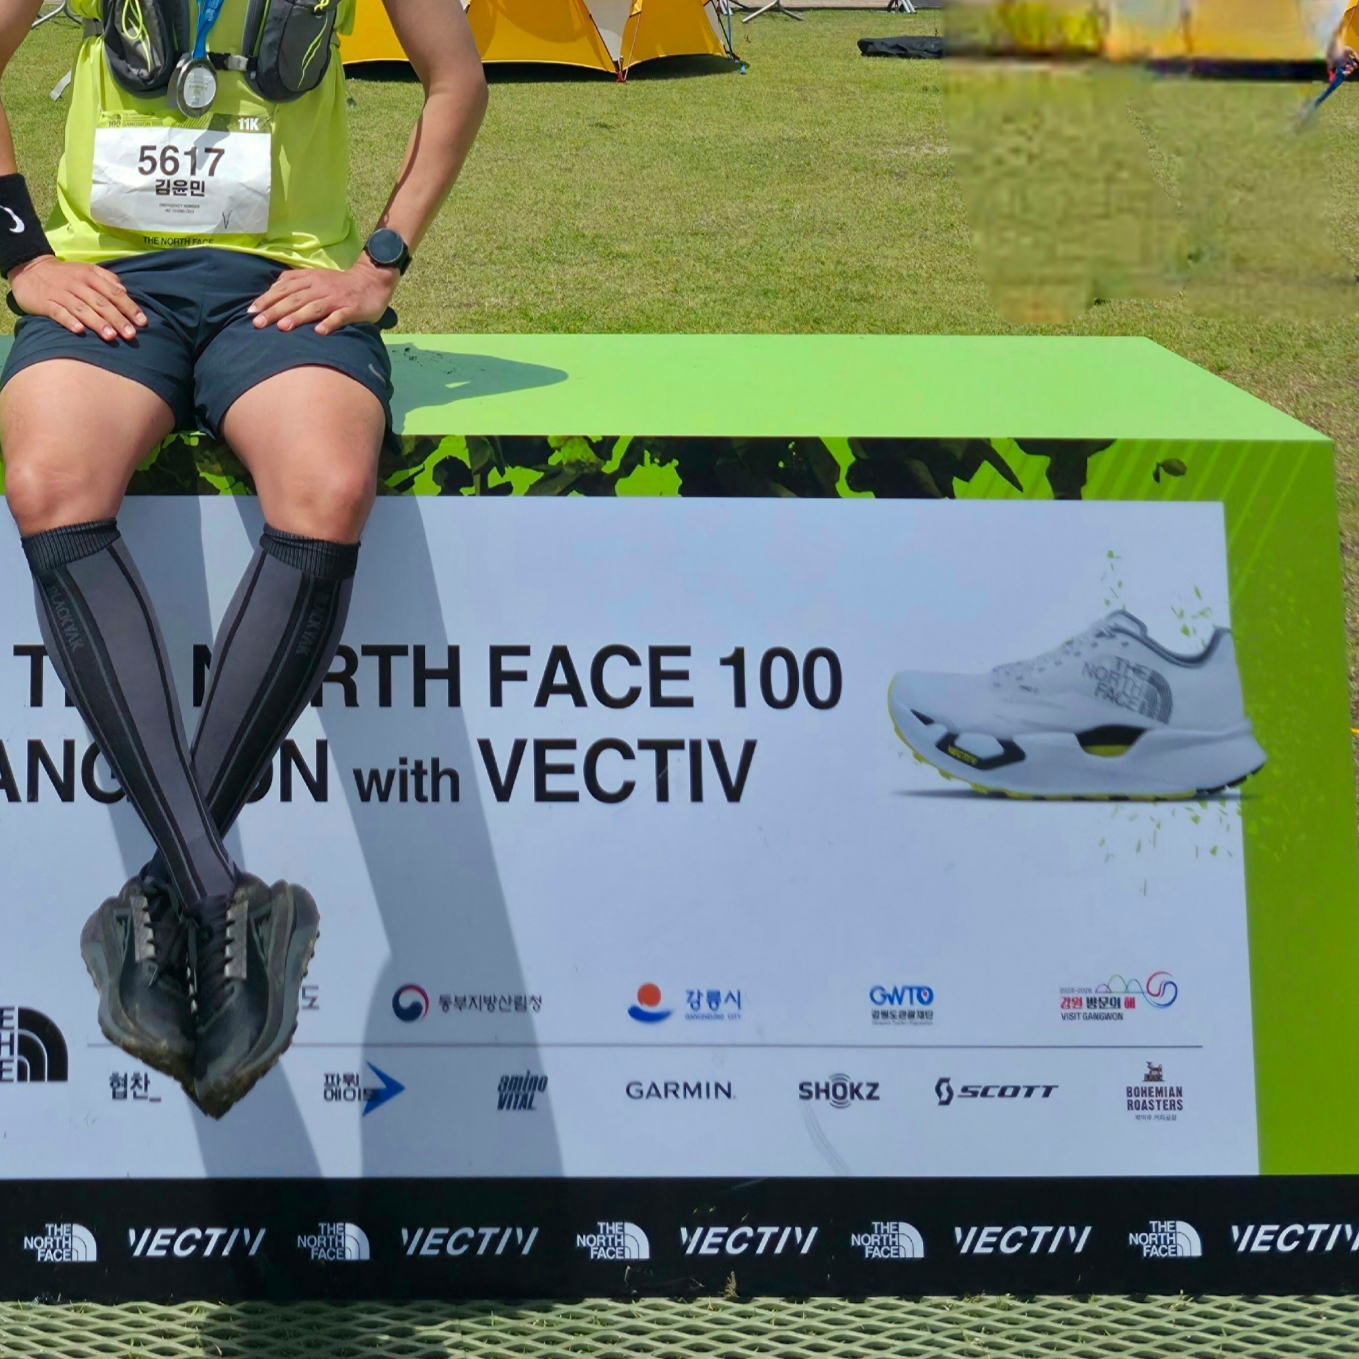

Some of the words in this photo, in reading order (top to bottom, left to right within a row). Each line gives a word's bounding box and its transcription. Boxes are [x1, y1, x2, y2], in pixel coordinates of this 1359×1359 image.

[238, 117, 260, 131] 11K
[138, 144, 225, 177] 5617
[155, 179, 205, 197] 김윤민
[143, 236, 159, 245] THE
[161, 237, 191, 246] NORTH
[488, 643, 695, 710] FACE
[719, 645, 842, 710] 100
[352, 756, 461, 804] with
[476, 737, 758, 804] VECTIV
[685, 988, 742, 1012] 강릉시
[869, 985, 934, 1006] GWTO
[1061, 1011, 1081, 1021] VISIT
[1082, 1012, 1124, 1021] GANGWON
[497, 1069, 549, 1094] amino
[625, 1080, 733, 1100] GARMIN
[798, 1081, 880, 1101] SHOKZ
[957, 1084, 1059, 1099] SCOTT
[1125, 1086, 1183, 1098] BOHEMIAN
[497, 1092, 535, 1110] VITAL
[1127, 1099, 1184, 1111] ROASTERS
[45, 1223, 73, 1236] THE
[318, 1222, 346, 1235] THE
[597, 1221, 625, 1234] THE
[872, 1221, 900, 1234] THE
[1150, 1220, 1178, 1233] THE
[24, 1235, 73, 1249] NORTH
[128, 1228, 266, 1257] VECTIV
[297, 1234, 346, 1248] NORTH
[401, 1227, 539, 1256] VECTIV
[576, 1233, 625, 1247] NORTH
[681, 1226, 818, 1255] VECTIV
[851, 1233, 900, 1247] NORTH
[954, 1225, 1091, 1254] VECTIV
[1129, 1232, 1178, 1246] NORTH
[37, 1247, 73, 1261] FACE
[310, 1246, 346, 1260] FACE
[589, 1245, 625, 1259] FACE
[864, 1245, 900, 1259] FACE
[1142, 1244, 1178, 1258] FACE
